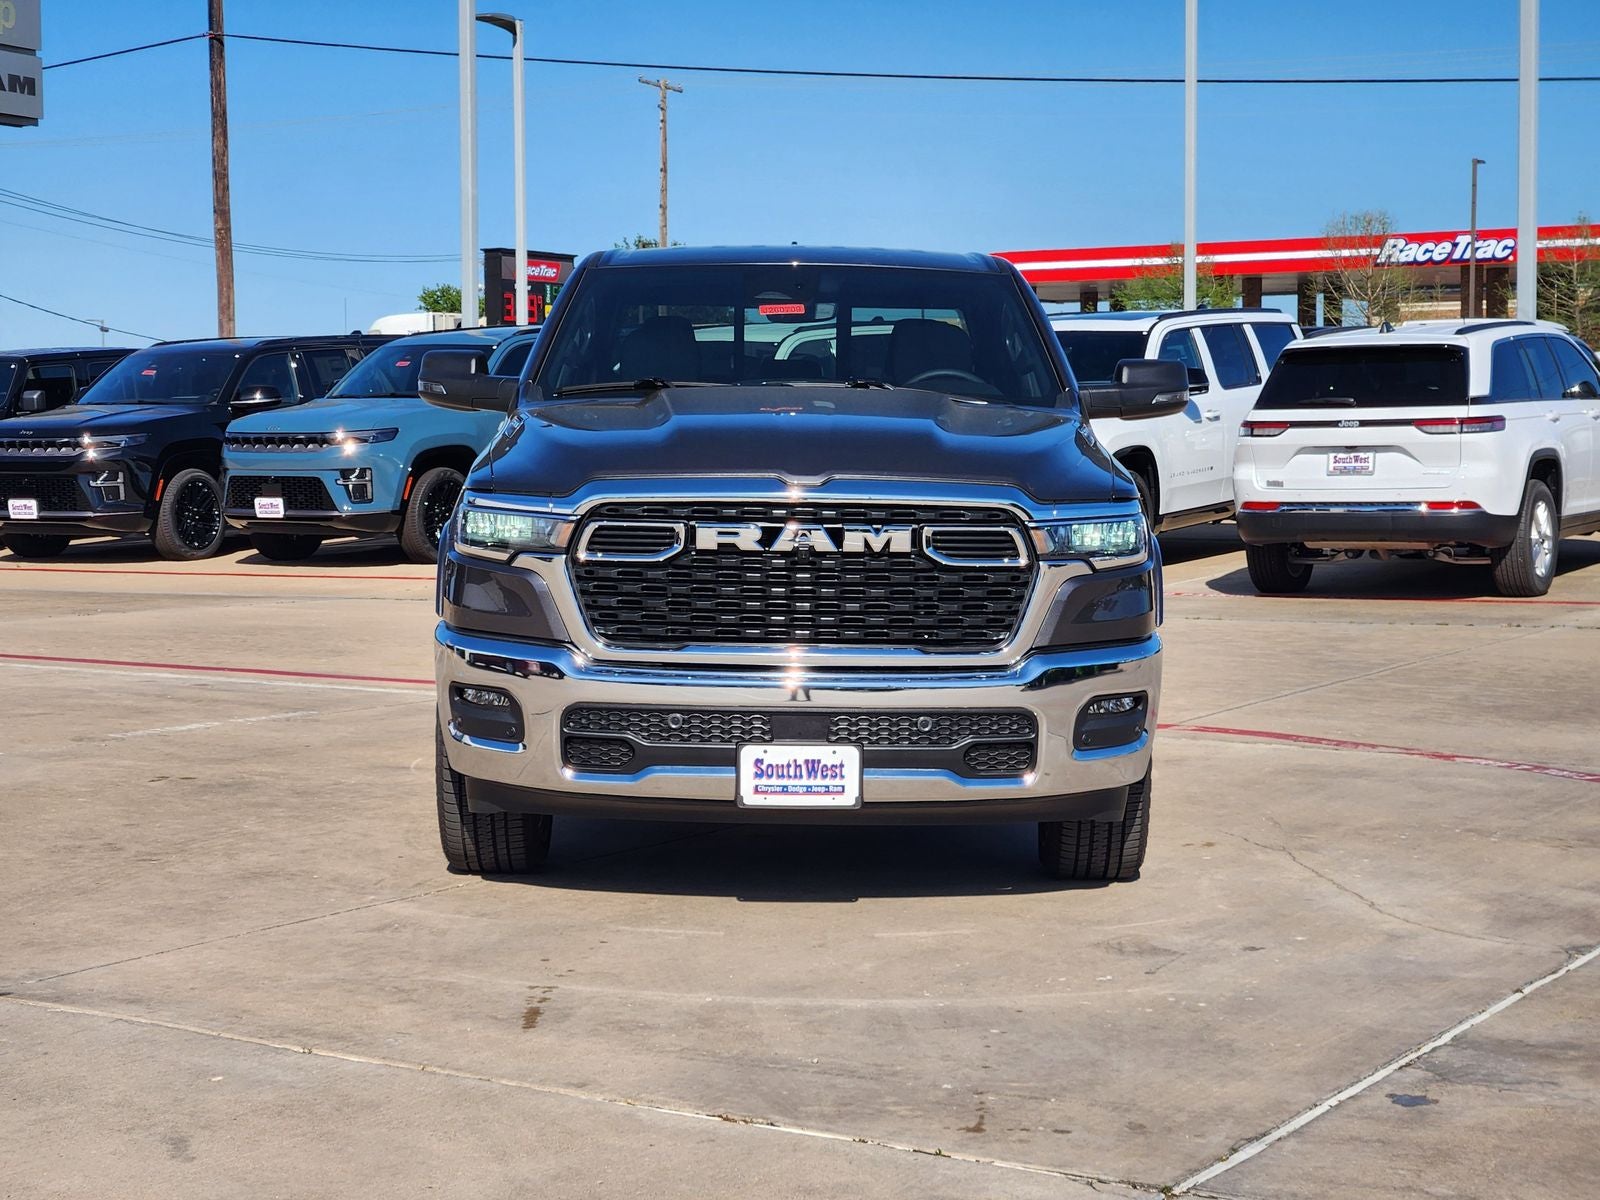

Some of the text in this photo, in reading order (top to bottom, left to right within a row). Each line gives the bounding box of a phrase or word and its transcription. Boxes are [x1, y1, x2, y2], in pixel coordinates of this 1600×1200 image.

[1376, 234, 1516, 264] RaceTrac
[527, 265, 557, 277] aceTrac
[1338, 420, 1360, 428] Jeep
[694, 521, 913, 553] RAM
[757, 785, 783, 793] Chrysler
[787, 785, 807, 793] Dodge
[811, 785, 826, 793] Jeep
